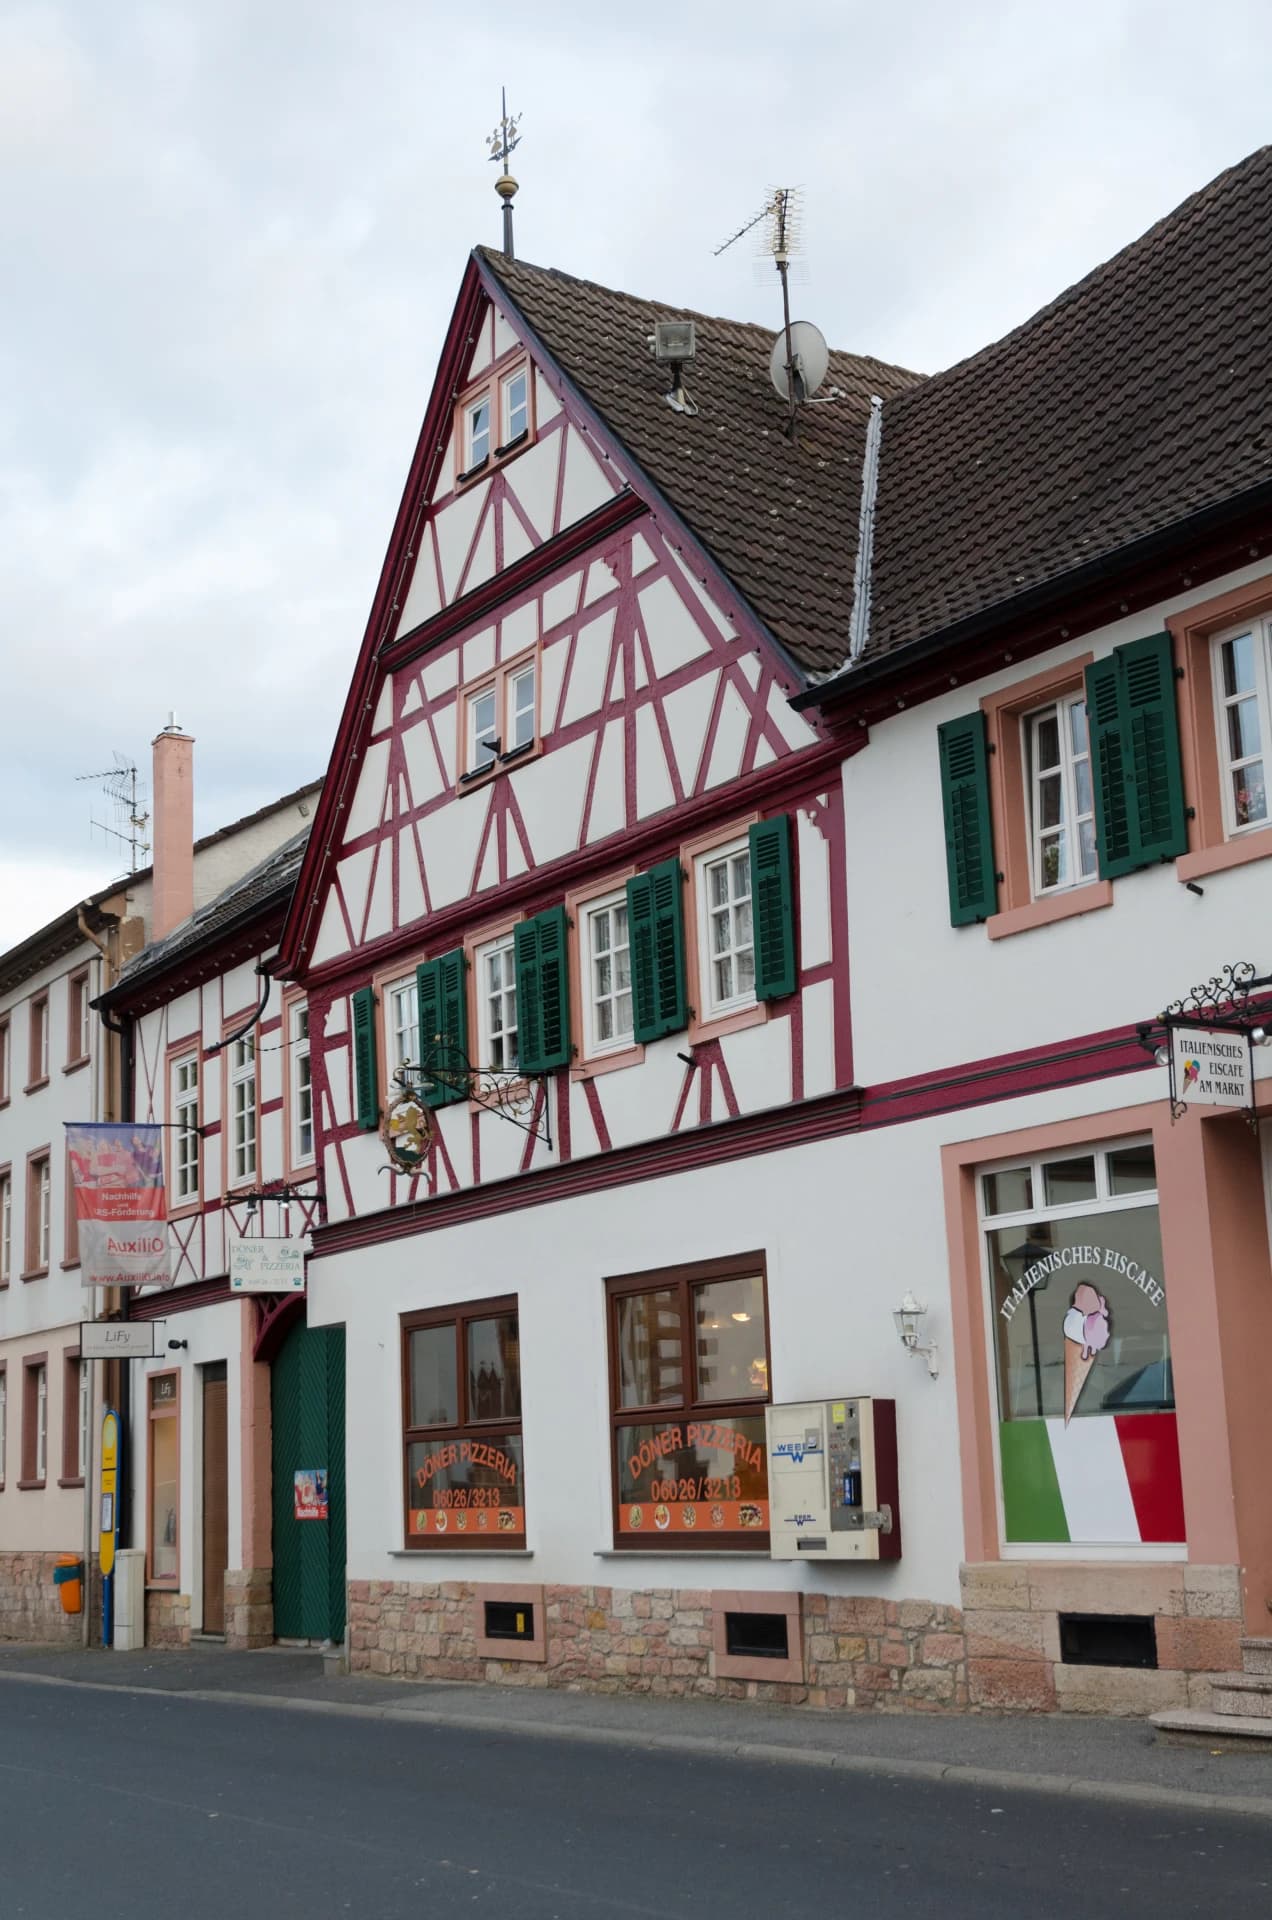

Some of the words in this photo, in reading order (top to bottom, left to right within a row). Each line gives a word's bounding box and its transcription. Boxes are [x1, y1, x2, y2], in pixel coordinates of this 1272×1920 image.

[1180, 1040, 1243, 1059] ITALIENISCHES
[1209, 1062, 1244, 1077] EISCAFE
[1200, 1080, 1212, 1093] AM
[1214, 1081, 1244, 1096] MARKT
[107, 1237, 164, 1253] AuxiliO
[1000, 1246, 1101, 1321] ITALIENISCHES
[1104, 1249, 1165, 1307] EISCAFE
[105, 1330, 131, 1344] LiFy
[629, 1427, 682, 1480] DÖNER
[687, 1424, 761, 1472] PIZZERIA
[416, 1443, 458, 1488] DÖNER
[460, 1442, 517, 1486] PIZZERIA
[433, 1488, 500, 1508] 06026/3213
[651, 1476, 742, 1501] 06026/3213
